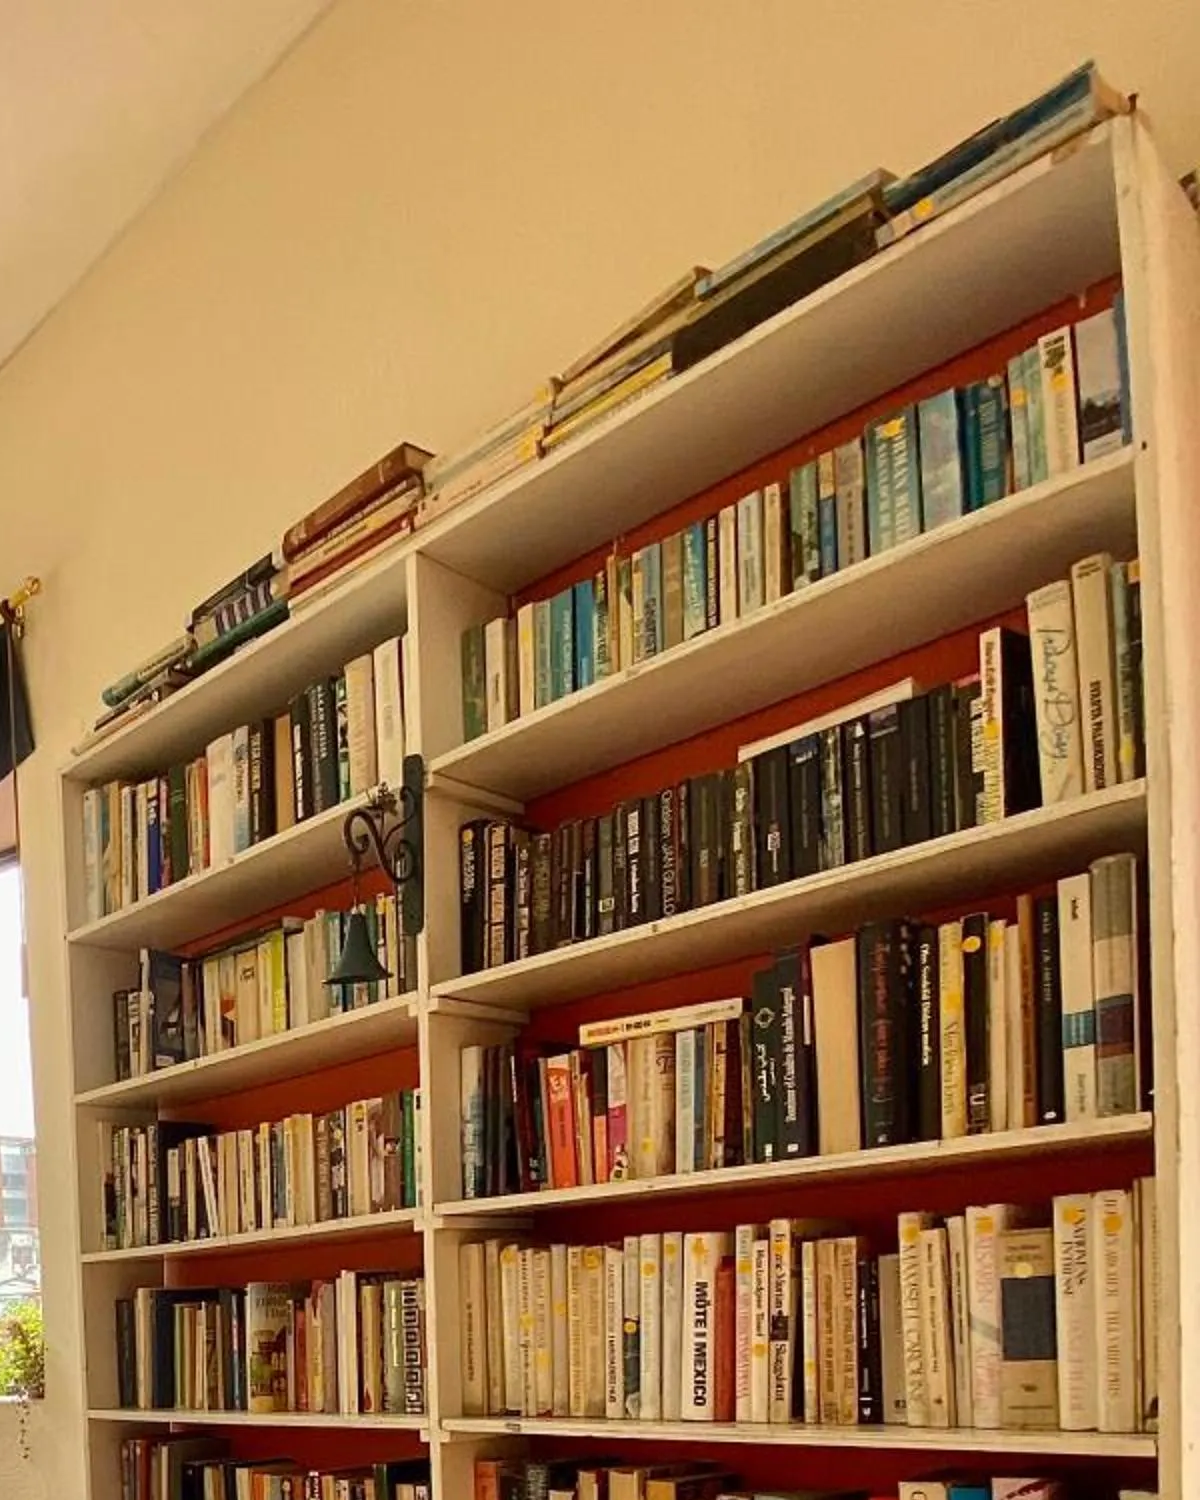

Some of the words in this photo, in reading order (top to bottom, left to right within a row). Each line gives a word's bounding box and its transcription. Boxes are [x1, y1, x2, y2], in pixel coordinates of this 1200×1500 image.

[663, 870, 676, 917] GUILLO
[694, 1282, 712, 1328] MÖTE
[693, 1342, 708, 1407] MEXICO
